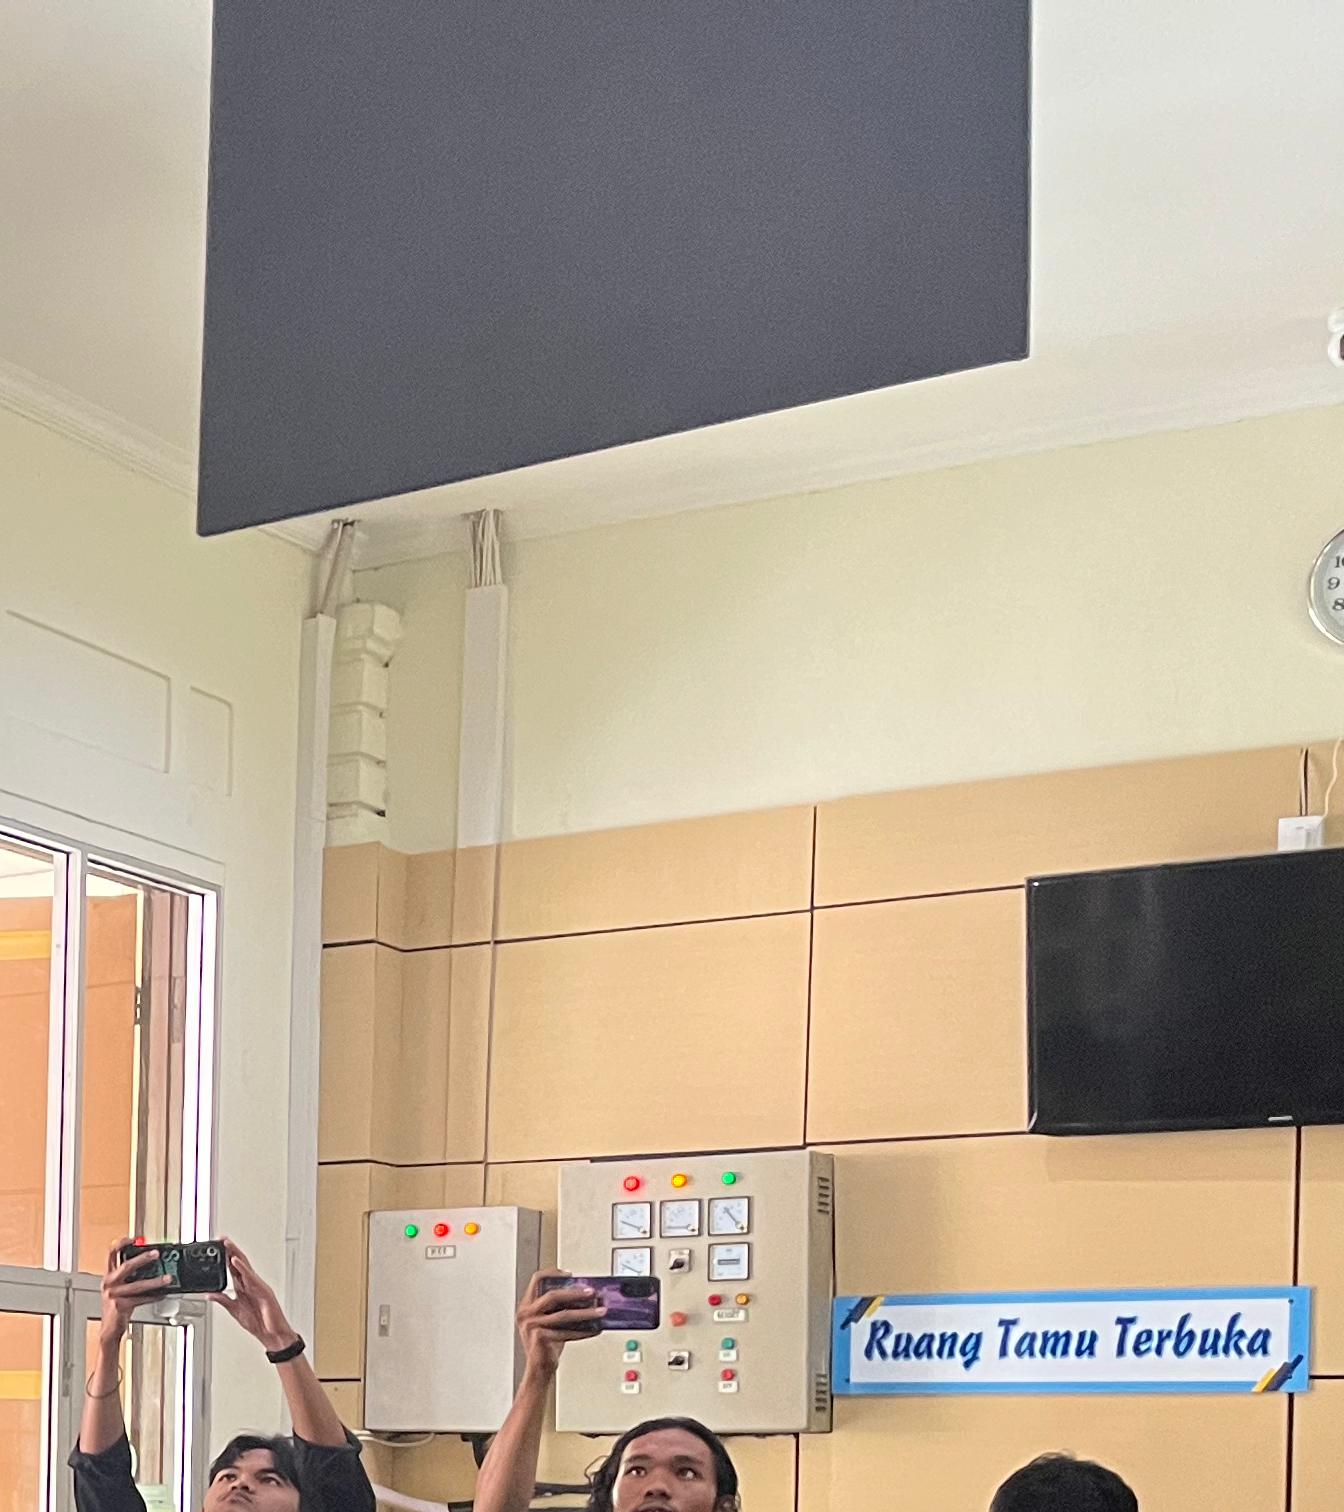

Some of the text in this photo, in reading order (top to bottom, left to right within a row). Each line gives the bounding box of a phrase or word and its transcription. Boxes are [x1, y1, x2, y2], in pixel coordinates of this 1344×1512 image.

[1328, 576, 1341, 590] 9
[1332, 597, 1344, 611] 8
[863, 1312, 1272, 1371] Ruang Tamu Terbuka
